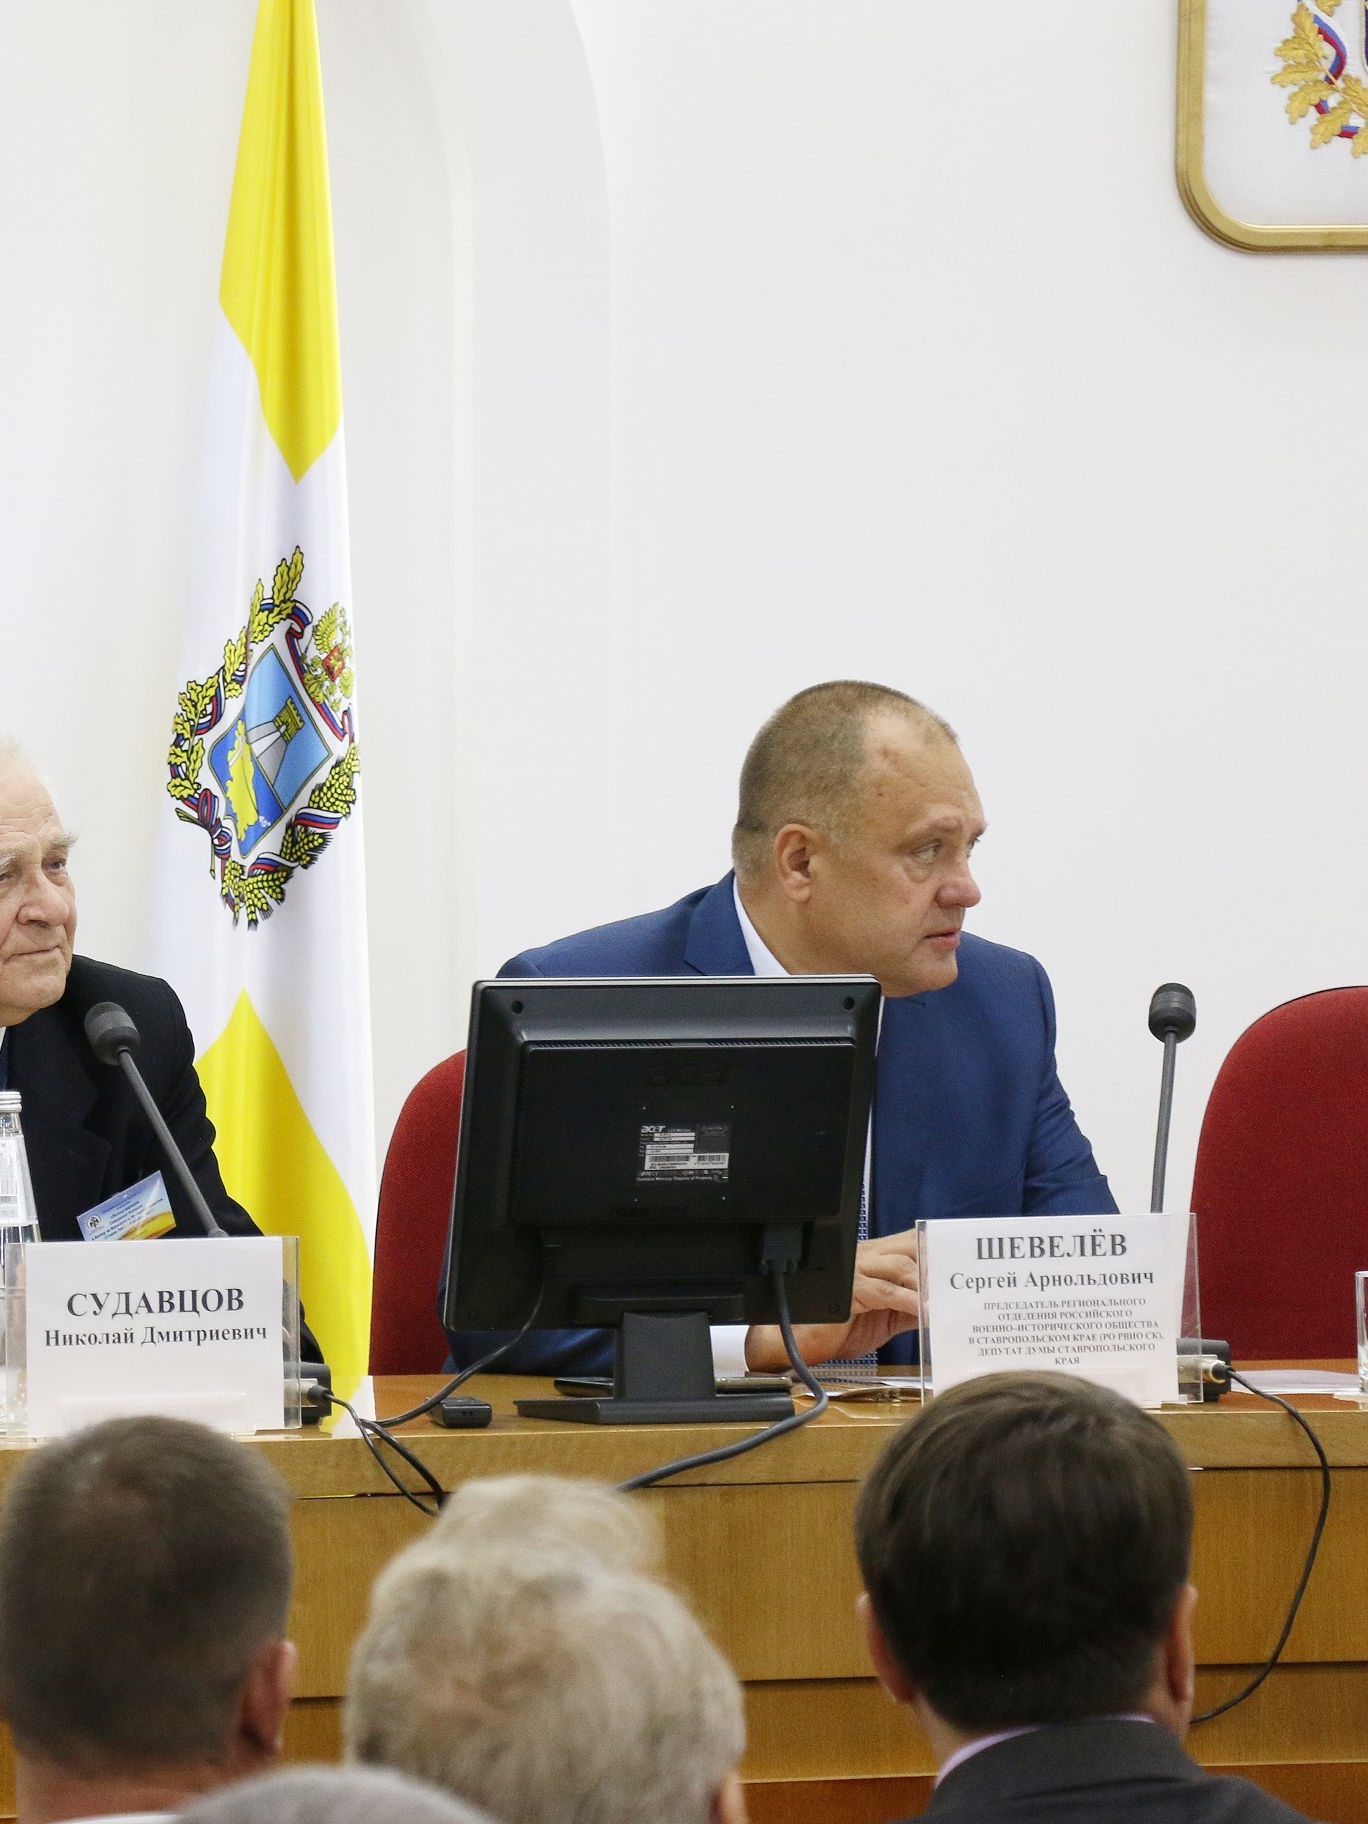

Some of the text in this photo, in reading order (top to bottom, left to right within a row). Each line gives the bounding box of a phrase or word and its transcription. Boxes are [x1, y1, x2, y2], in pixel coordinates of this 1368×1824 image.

[641, 1125, 666, 1133] acer
[976, 1229, 1127, 1260] ШЕВЕЛЁВ
[950, 1271, 1154, 1293] Сергей Арнольдович
[67, 1288, 244, 1320] СУДАВЦОВ
[983, 1298, 1146, 1311] ПРЕДСЕДАТЕЛЬ РЕГИОНАЛЬНОГО
[998, 1309, 1132, 1321] ОТДЕЛЕНИЯ РОССИЙСКОГО
[1105, 1320, 1159, 1330] ОБЩЕСТВА
[46, 1327, 267, 1347] Николай Дмитриевич
[977, 1334, 1070, 1344] СТАВРОПОЛЬСКОМ
[1073, 1333, 1097, 1342] КРАЕ
[979, 1343, 1155, 1357] ДЕПУТАТ ДУМЫ СТАВРОПОЛЬСКОГО
[1055, 1357, 1080, 1365] КРАЯ
